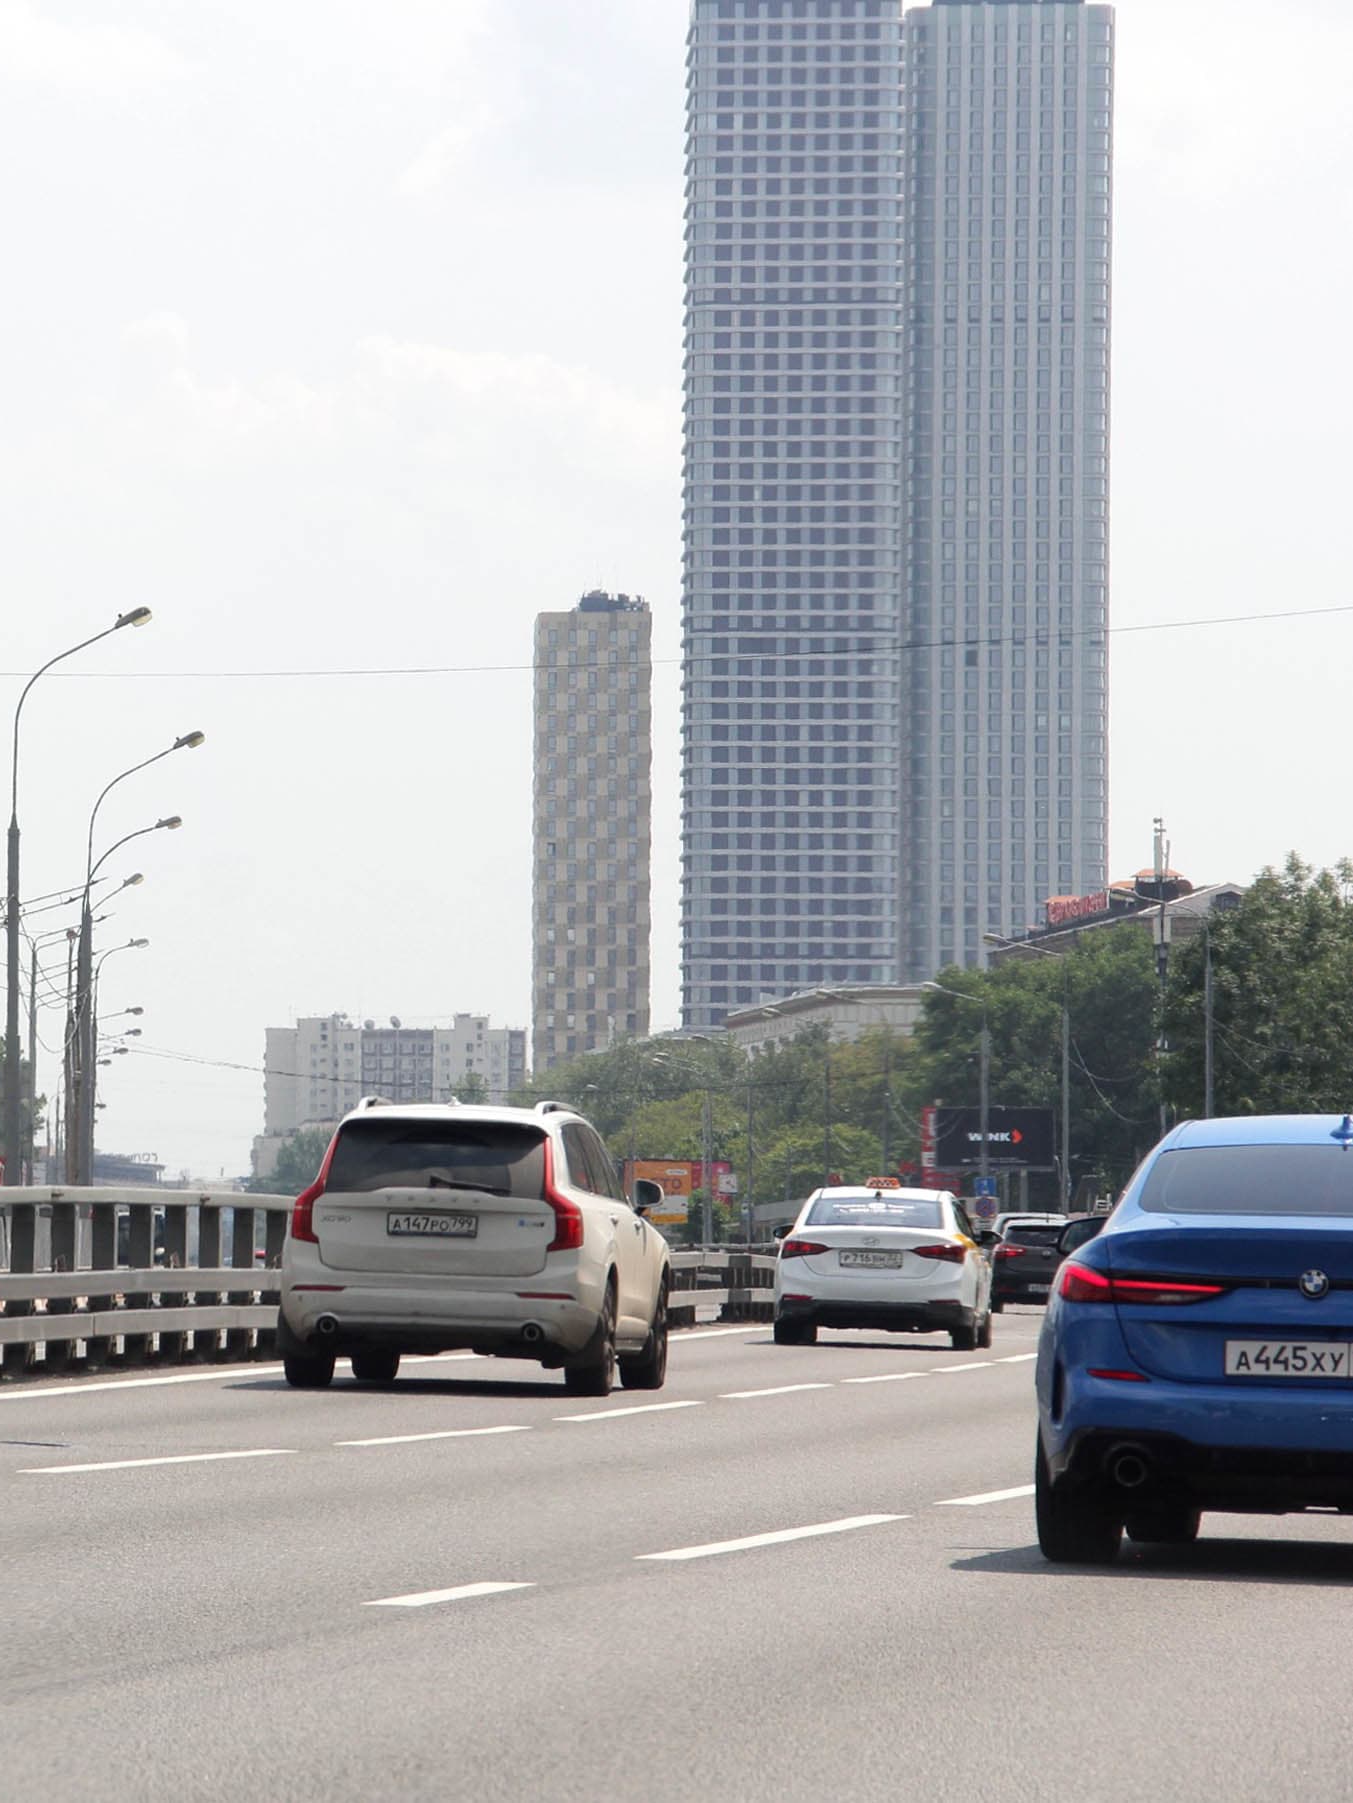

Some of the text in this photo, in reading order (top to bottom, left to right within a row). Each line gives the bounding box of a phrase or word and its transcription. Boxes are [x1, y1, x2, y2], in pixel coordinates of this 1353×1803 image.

[392, 1216, 473, 1231] А147РО 799
[1235, 1344, 1345, 1372] А445ХУ
